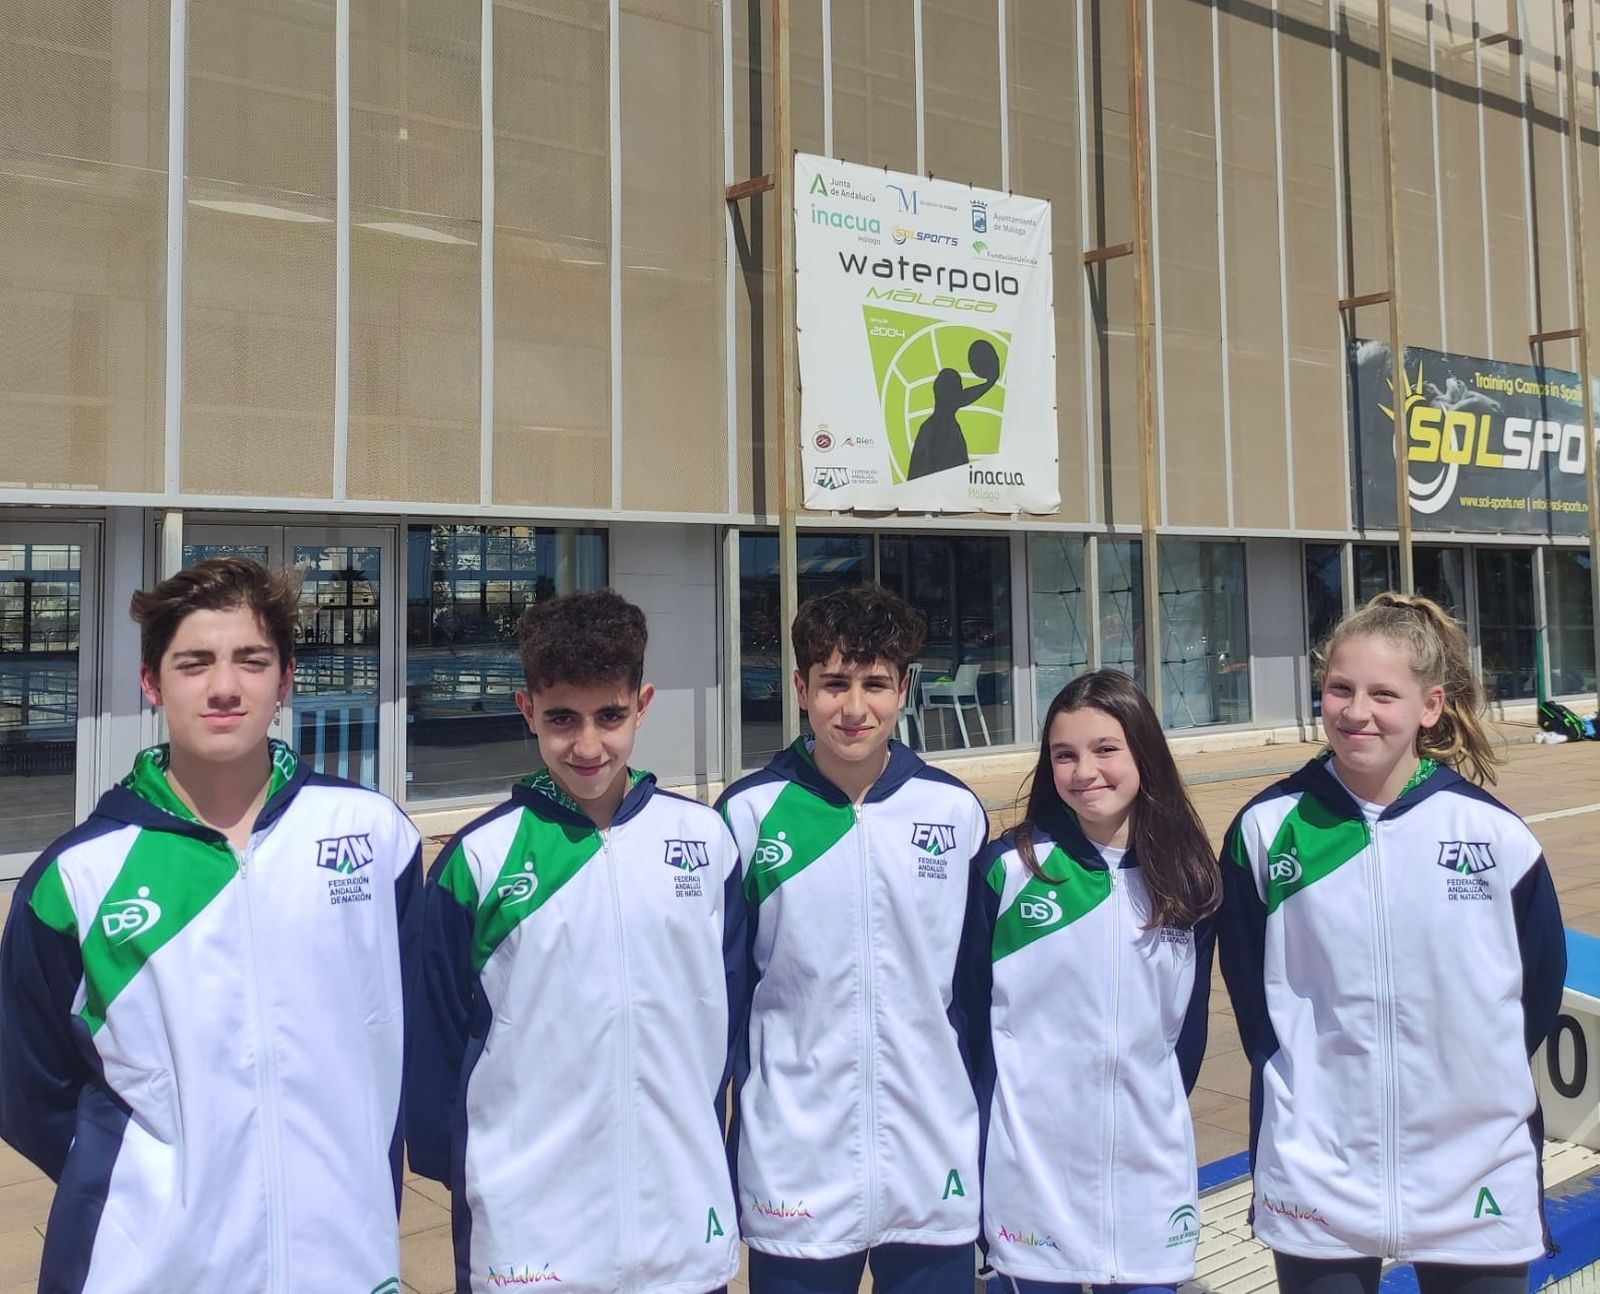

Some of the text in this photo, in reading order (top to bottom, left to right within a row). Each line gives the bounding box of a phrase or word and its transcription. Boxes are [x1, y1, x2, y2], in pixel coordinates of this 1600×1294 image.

[830, 178, 851, 188] Junta
[830, 188, 876, 202] de Andalucía
[811, 203, 880, 234] inacua
[870, 325, 905, 339] 2004
[1474, 371, 1583, 402] Training Camps in Spai
[1408, 406, 1587, 474] SOLSPO
[969, 464, 1025, 486] inacua
[315, 832, 374, 874] FAN
[911, 822, 956, 856] FAN
[663, 839, 709, 873] FAN
[1437, 841, 1497, 875] FAN
[1020, 902, 1049, 920] DS
[1448, 893, 1458, 901] DE
[102, 906, 143, 938] DS
[1546, 1013, 1588, 1099] 0
[998, 1224, 1062, 1250] Andalucía
[486, 1262, 563, 1287] Andalucía
